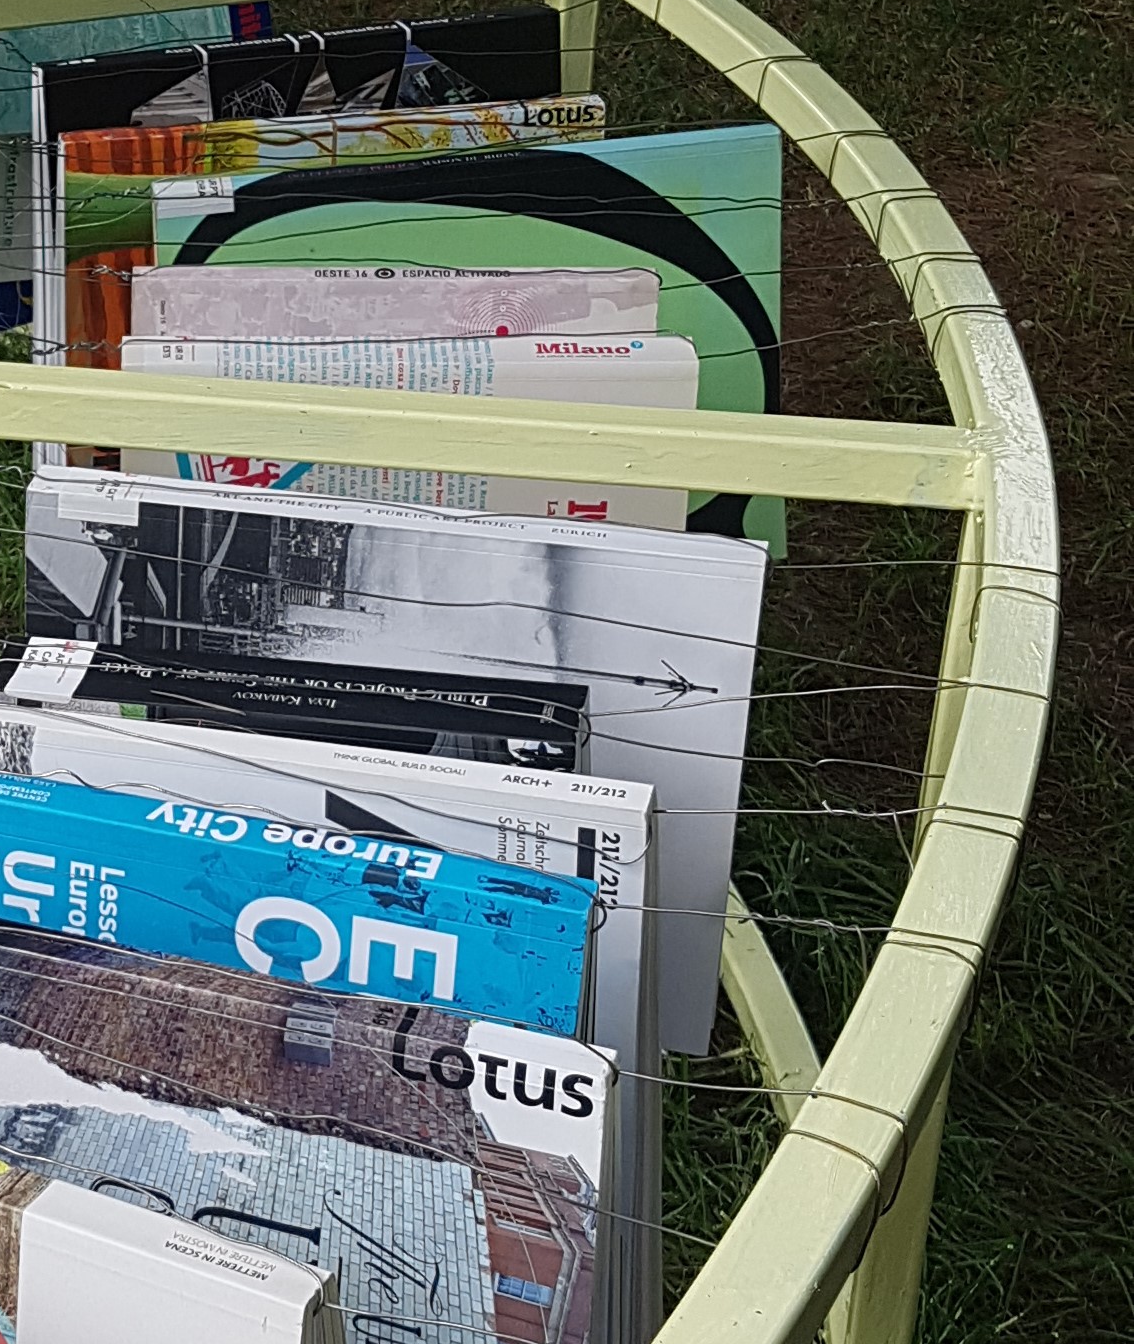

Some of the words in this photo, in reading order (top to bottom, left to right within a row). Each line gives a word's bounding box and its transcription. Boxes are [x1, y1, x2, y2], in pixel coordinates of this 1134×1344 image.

[2, 136, 19, 248] frastructure
[314, 270, 351, 278] OESTE
[356, 270, 368, 278] 16
[402, 270, 451, 278] ESPACIO
[535, 342, 631, 354] Milano
[212, 492, 240, 500] ART
[243, 496, 274, 504] AND
[277, 499, 307, 507] THE
[308, 502, 342, 511] CITY
[377, 509, 429, 520] PUBLIC
[462, 518, 529, 531] PROJECT
[550, 527, 608, 538] ZURICH
[333, 751, 360, 762] THINK
[400, 761, 427, 771] BUILD
[10, 789, 48, 802] CENTRE
[500, 771, 554, 792] ARCH+
[569, 781, 629, 801] 211/212
[146, 801, 249, 843] City
[262, 822, 444, 880] Europe
[599, 831, 619, 911] 211/212
[371, 1007, 393, 1026] 149
[392, 1006, 597, 1120] Lotus
[162, 1238, 201, 1258] SCENA
[171, 1229, 217, 1252] MOSTRA
[214, 1244, 228, 1256] IN
[324, 1189, 443, 1316] The
[200, 1251, 215, 1263] IN
[213, 1256, 269, 1281] METTERE
[227, 1248, 276, 1272] METTERE
